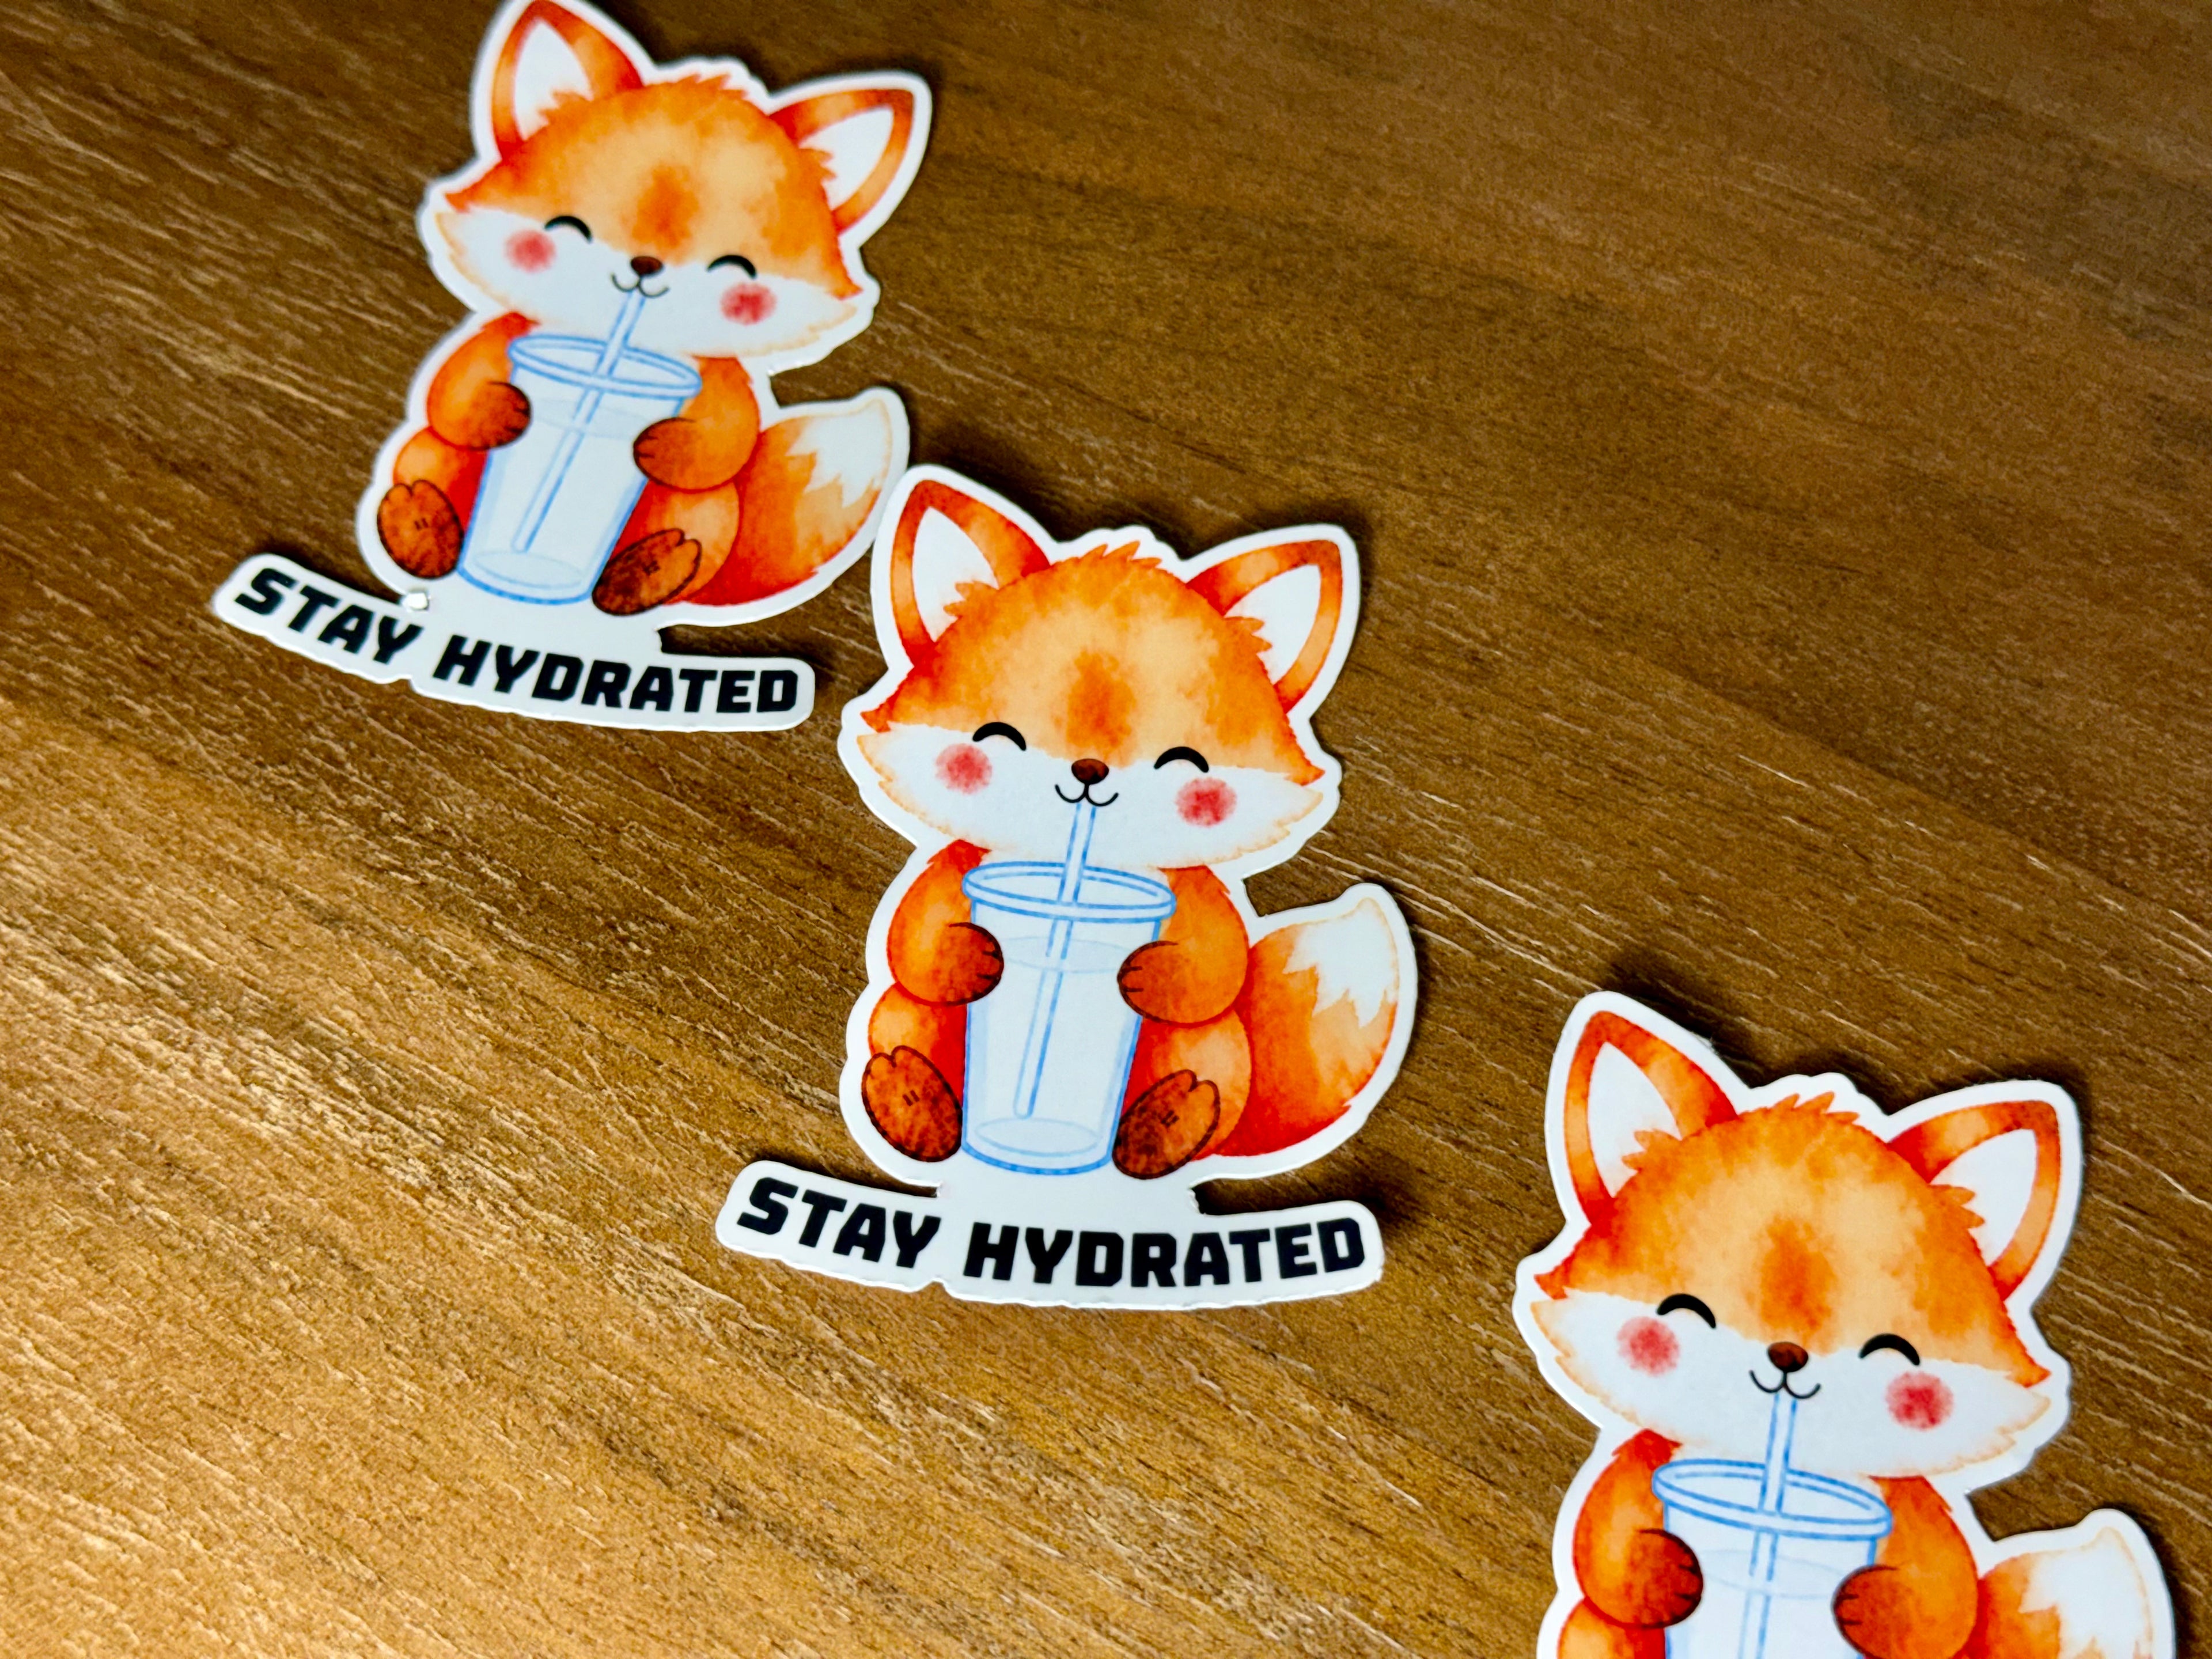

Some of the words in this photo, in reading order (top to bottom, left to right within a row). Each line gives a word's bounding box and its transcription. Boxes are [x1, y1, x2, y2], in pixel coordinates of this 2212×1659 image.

[234, 567, 422, 664] STAY
[433, 635, 799, 714] HYDRATED
[736, 1177, 942, 1269] STAY
[963, 1217, 1366, 1288] HYDRATED
